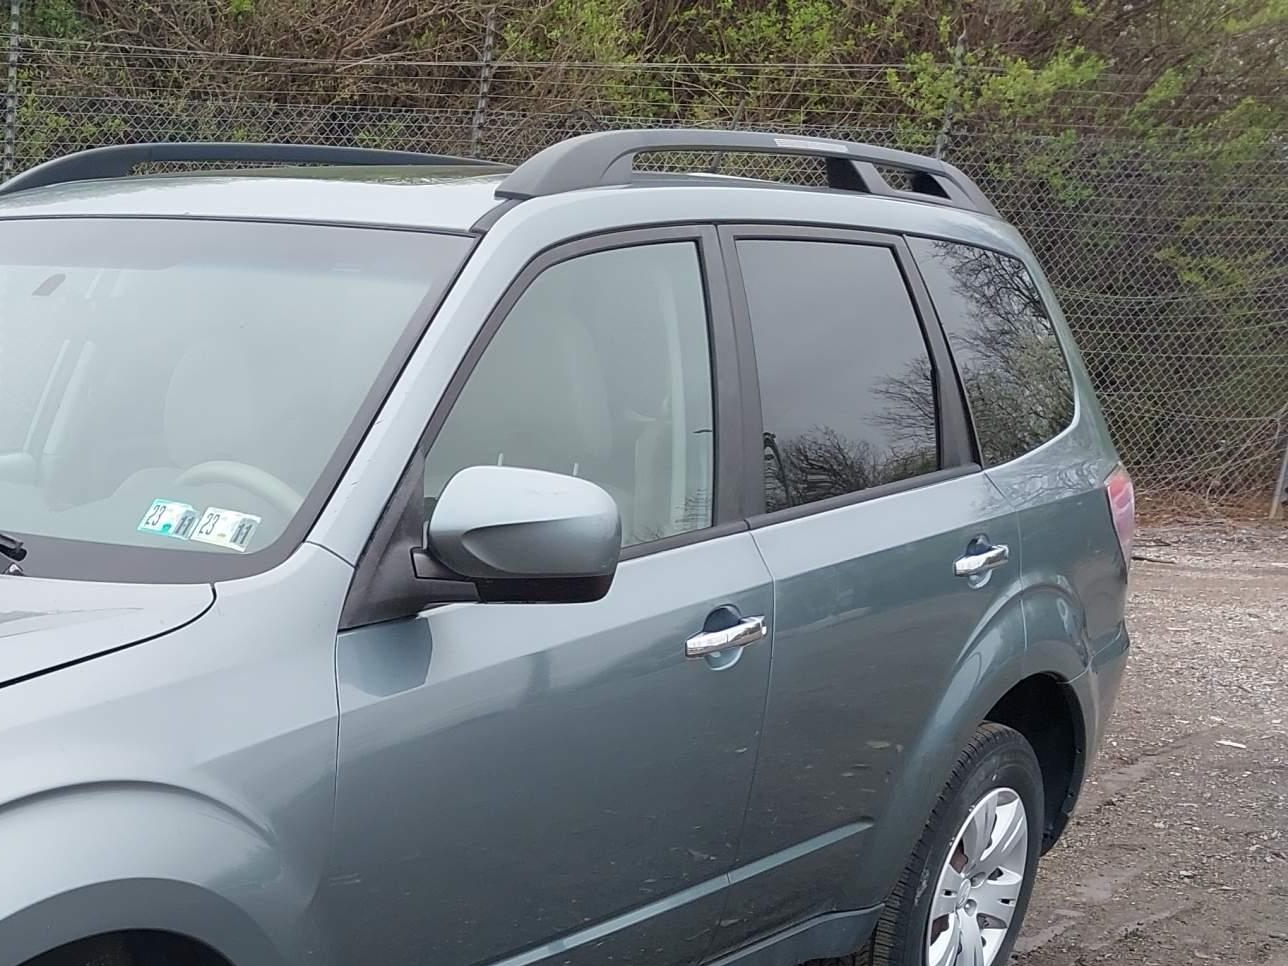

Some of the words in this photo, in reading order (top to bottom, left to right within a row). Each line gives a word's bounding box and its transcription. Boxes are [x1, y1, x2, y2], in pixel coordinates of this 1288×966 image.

[145, 504, 167, 526] 23
[175, 516, 195, 537] 11
[198, 512, 221, 536] 23
[232, 523, 253, 545] 11
